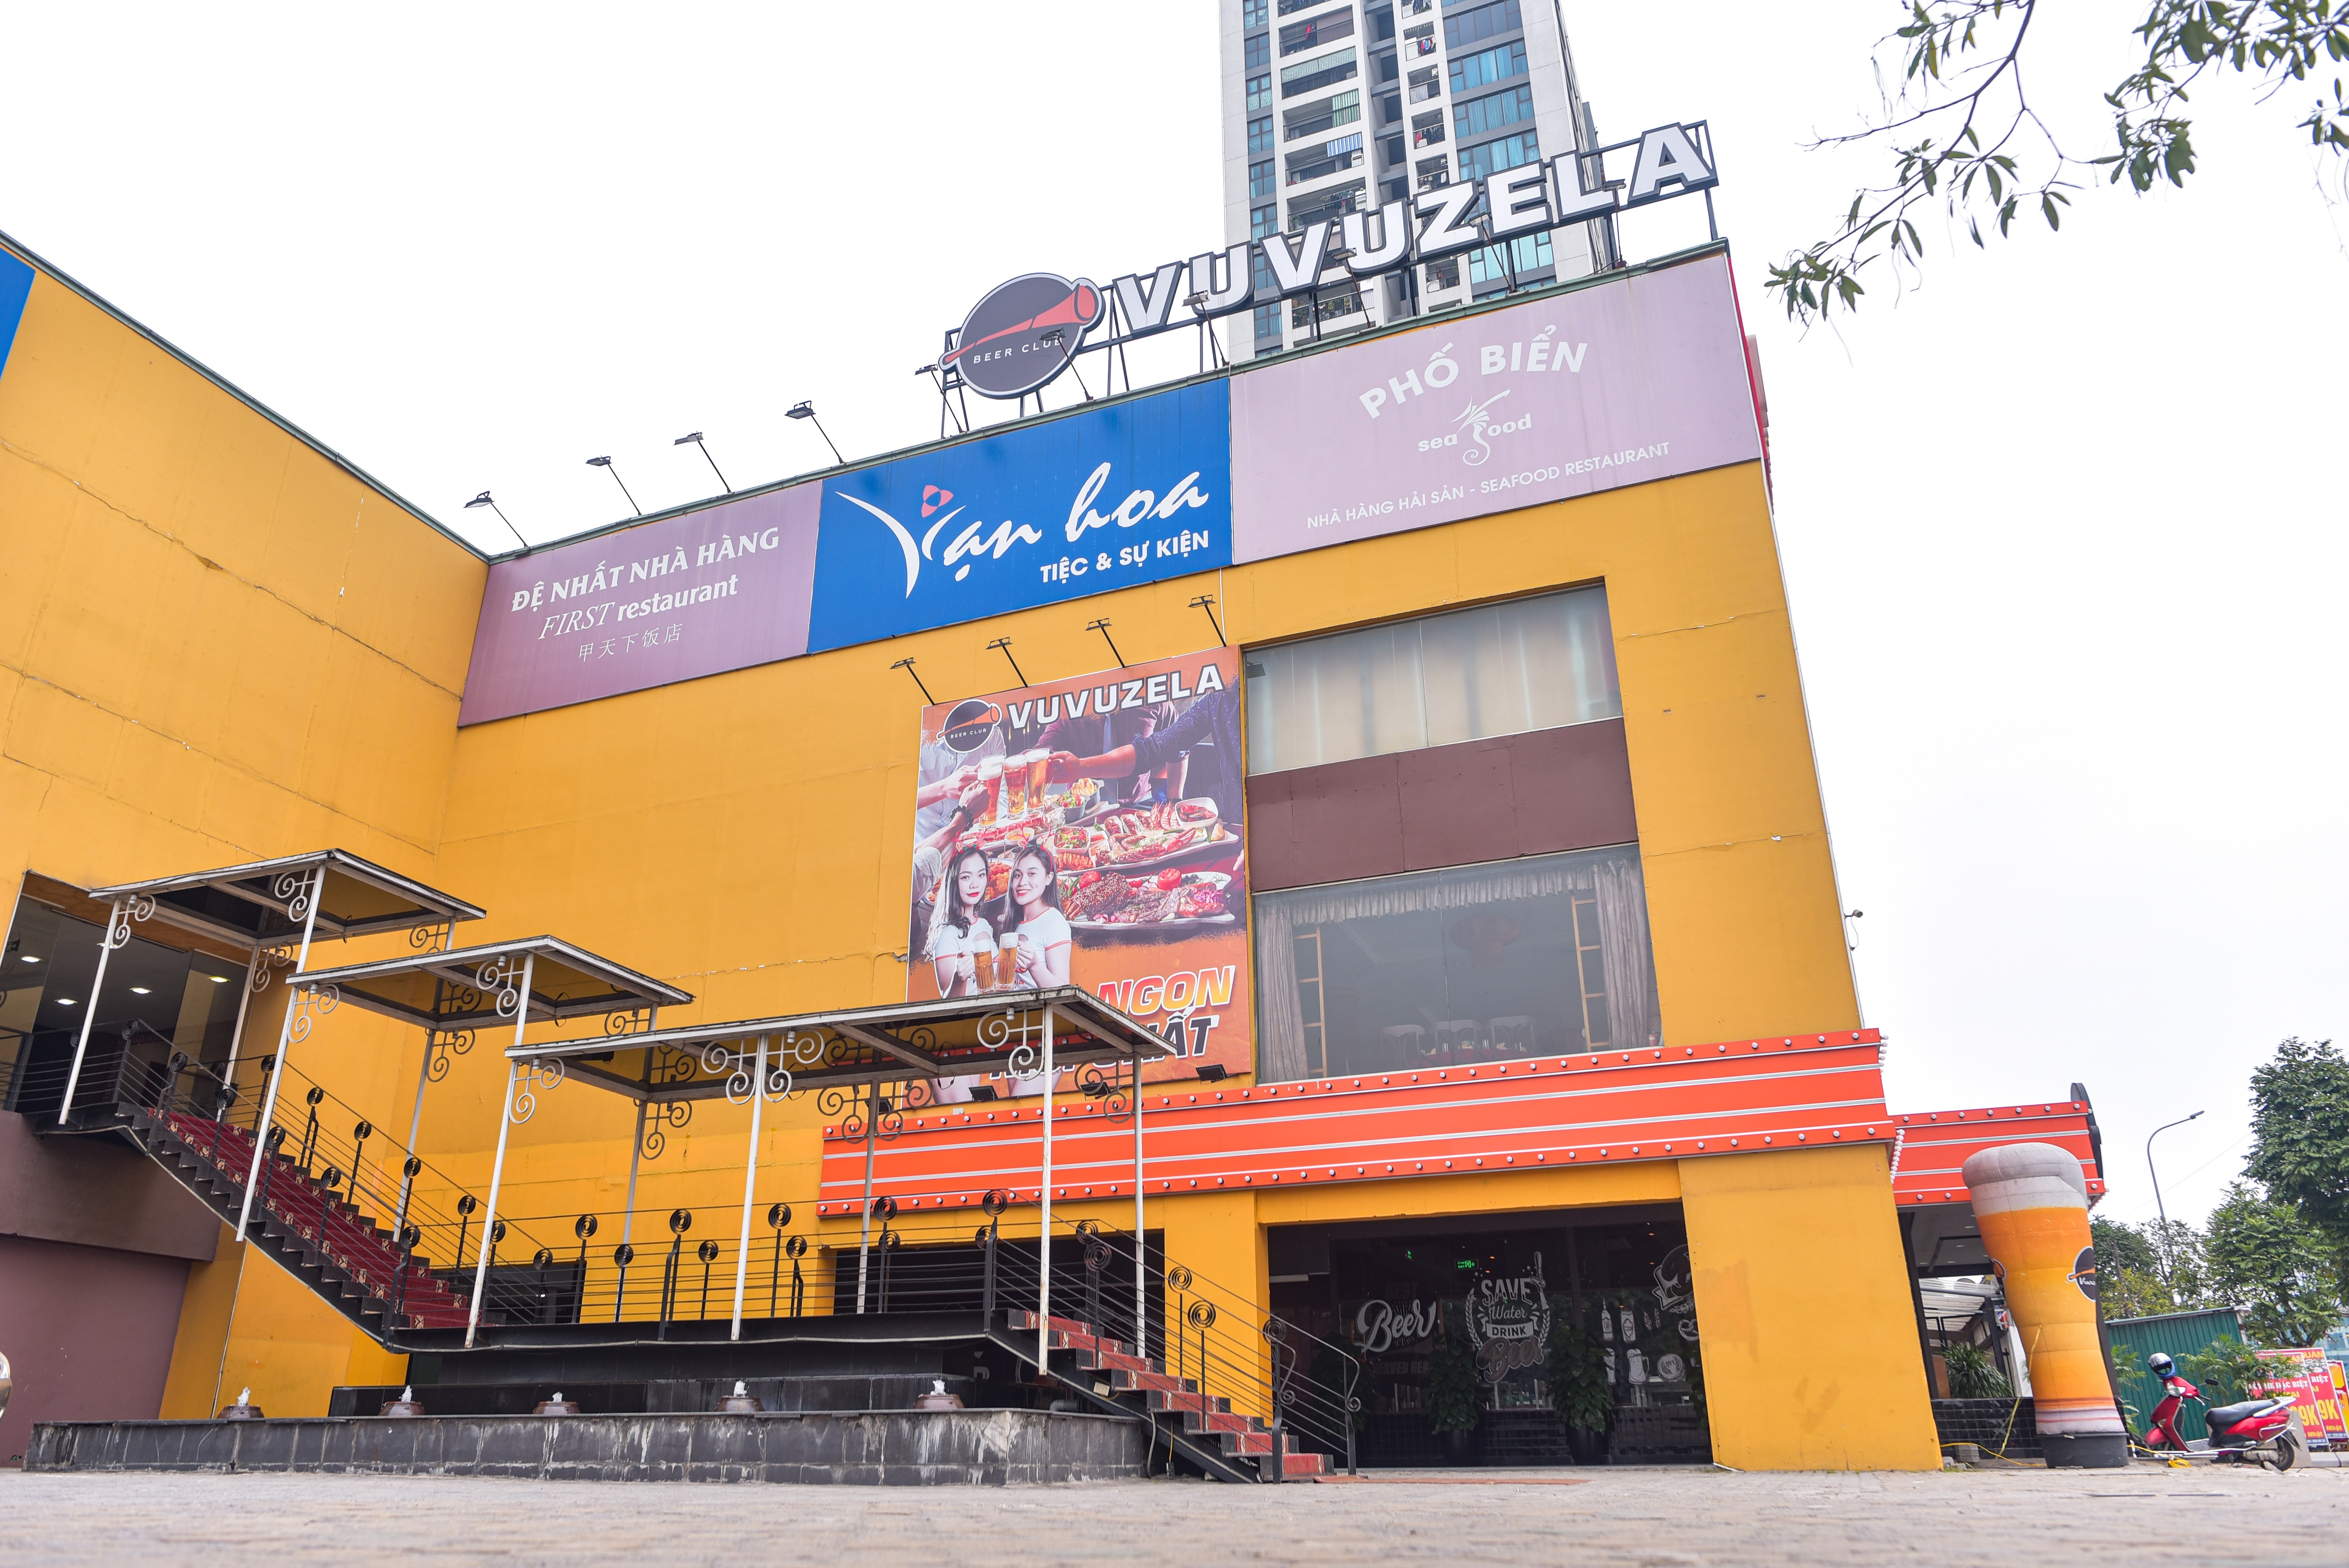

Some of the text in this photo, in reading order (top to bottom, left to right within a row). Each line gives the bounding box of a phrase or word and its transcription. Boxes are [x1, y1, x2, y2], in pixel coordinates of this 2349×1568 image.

[1113, 122, 1717, 335] VUVUZELA
[973, 338, 1062, 364] BEER CLUB
[1359, 324, 1588, 419] PHỐ BIỂN
[1065, 461, 1209, 542] hoa
[1307, 508, 1341, 529] NHÀ
[1346, 501, 1394, 521] HÀNG
[1399, 491, 1426, 510] HẢI
[1431, 485, 1464, 504] SẢN
[1480, 466, 1560, 494] SEAFOOD
[1565, 442, 1670, 476] RESTAURANT
[511, 527, 779, 613] ĐỆ NHẤT NHÀ HÀNG
[1040, 529, 1209, 584] TIỆC & SỰ KIỆN
[538, 574, 739, 640] FIRST restaurant
[579, 624, 683, 662] 甲天下饭店
[1007, 663, 1226, 730] VUVUZELA
[1097, 965, 1235, 1016] NGON
[1481, 1278, 1533, 1306] SAVE
[1489, 1304, 1527, 1320] Water
[1353, 1299, 1436, 1352] Beer
[1492, 1326, 1527, 1336] DRINK
[1476, 1335, 1544, 1383] Beer
[2292, 1379, 2308, 1389] BIỆT
[2311, 1375, 2328, 1384] BIỆT
[2290, 1404, 2320, 1426] 9K
